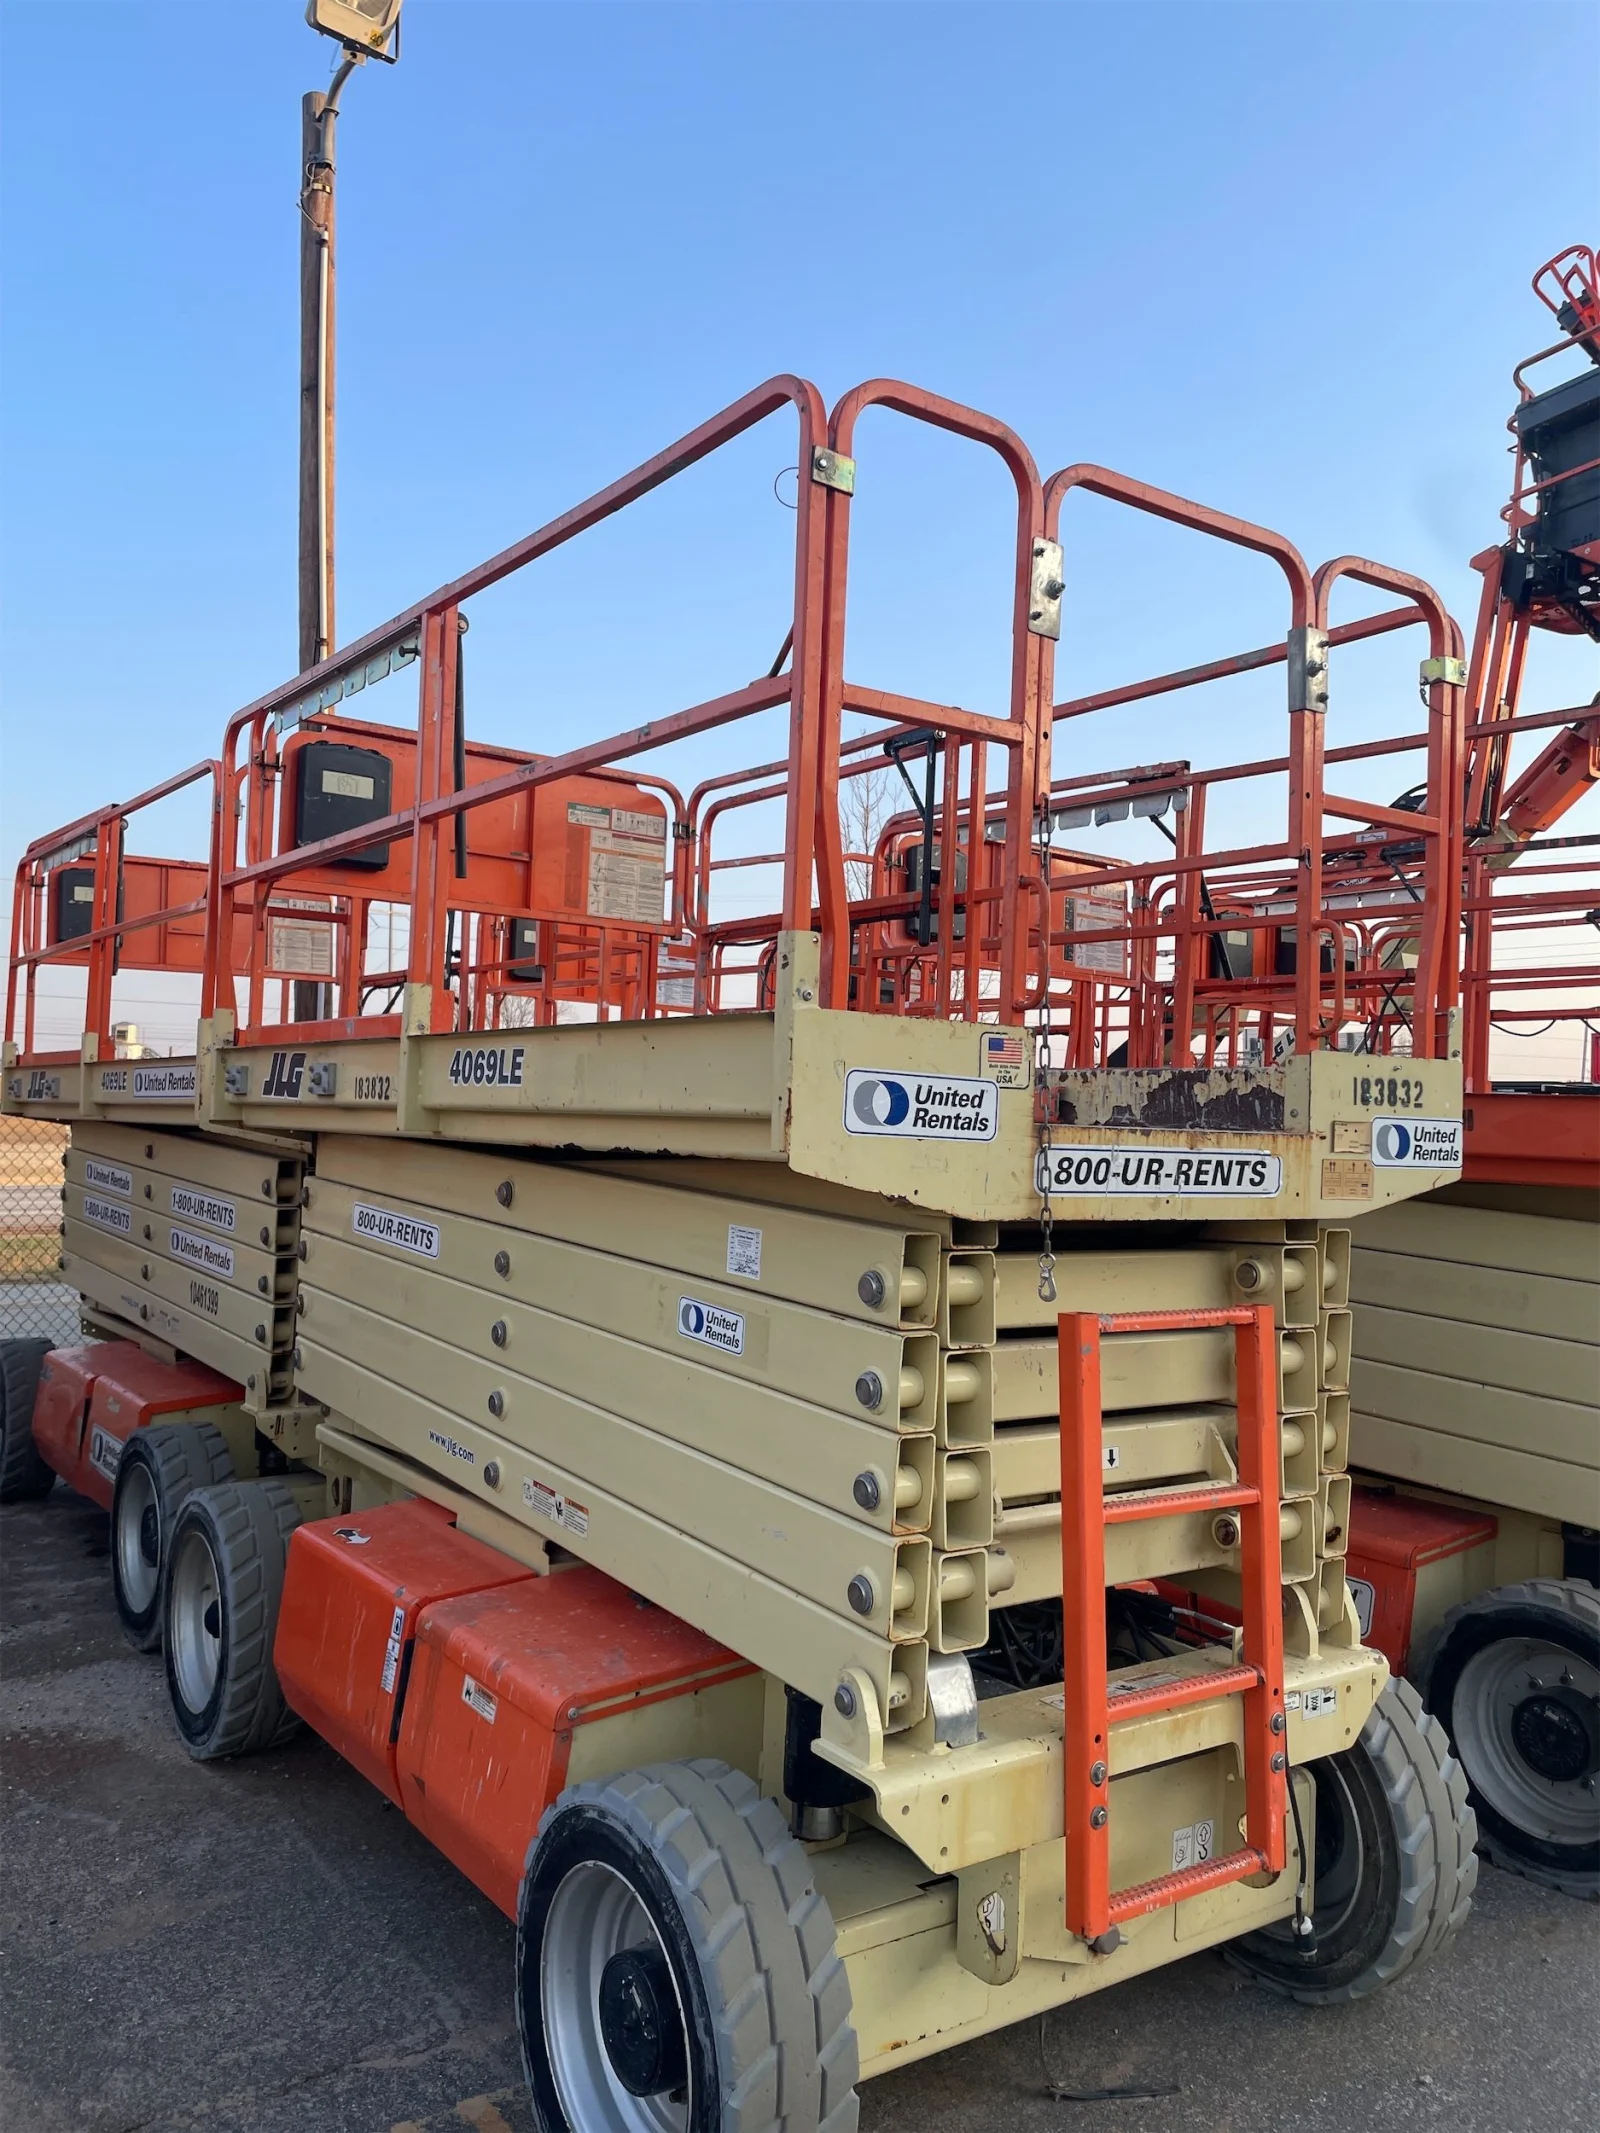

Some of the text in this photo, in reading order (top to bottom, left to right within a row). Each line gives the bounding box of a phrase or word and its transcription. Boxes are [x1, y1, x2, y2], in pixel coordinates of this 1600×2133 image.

[370, 33, 384, 46] 40
[262, 1052, 306, 1099] JLG
[450, 1048, 525, 1086] 4069LE
[996, 1074, 1013, 1084] USA
[102, 1071, 127, 1091] 4069LE
[144, 1072, 196, 1091] United Rentals
[354, 1076, 391, 1100] 183832
[1352, 1076, 1424, 1108] 183832
[914, 1083, 985, 1110] United
[912, 1107, 990, 1132] Rentals
[1413, 1124, 1456, 1144] United
[1412, 1143, 1460, 1164] Rentals
[93, 1167, 130, 1191] United Rentals
[1053, 1157, 1268, 1188] 800-UR-RENTS
[85, 1200, 130, 1230] 1-800-UR-RENTS
[172, 1191, 234, 1227] 1-800-UR-RENTS
[357, 1209, 434, 1251] 800-UR-RENTS
[180, 1239, 231, 1272] United Rentals
[190, 1280, 219, 1316] 10461399
[705, 1310, 738, 1333] United
[704, 1325, 741, 1350] Rentals
[429, 1430, 475, 1464] www.jlg.com
